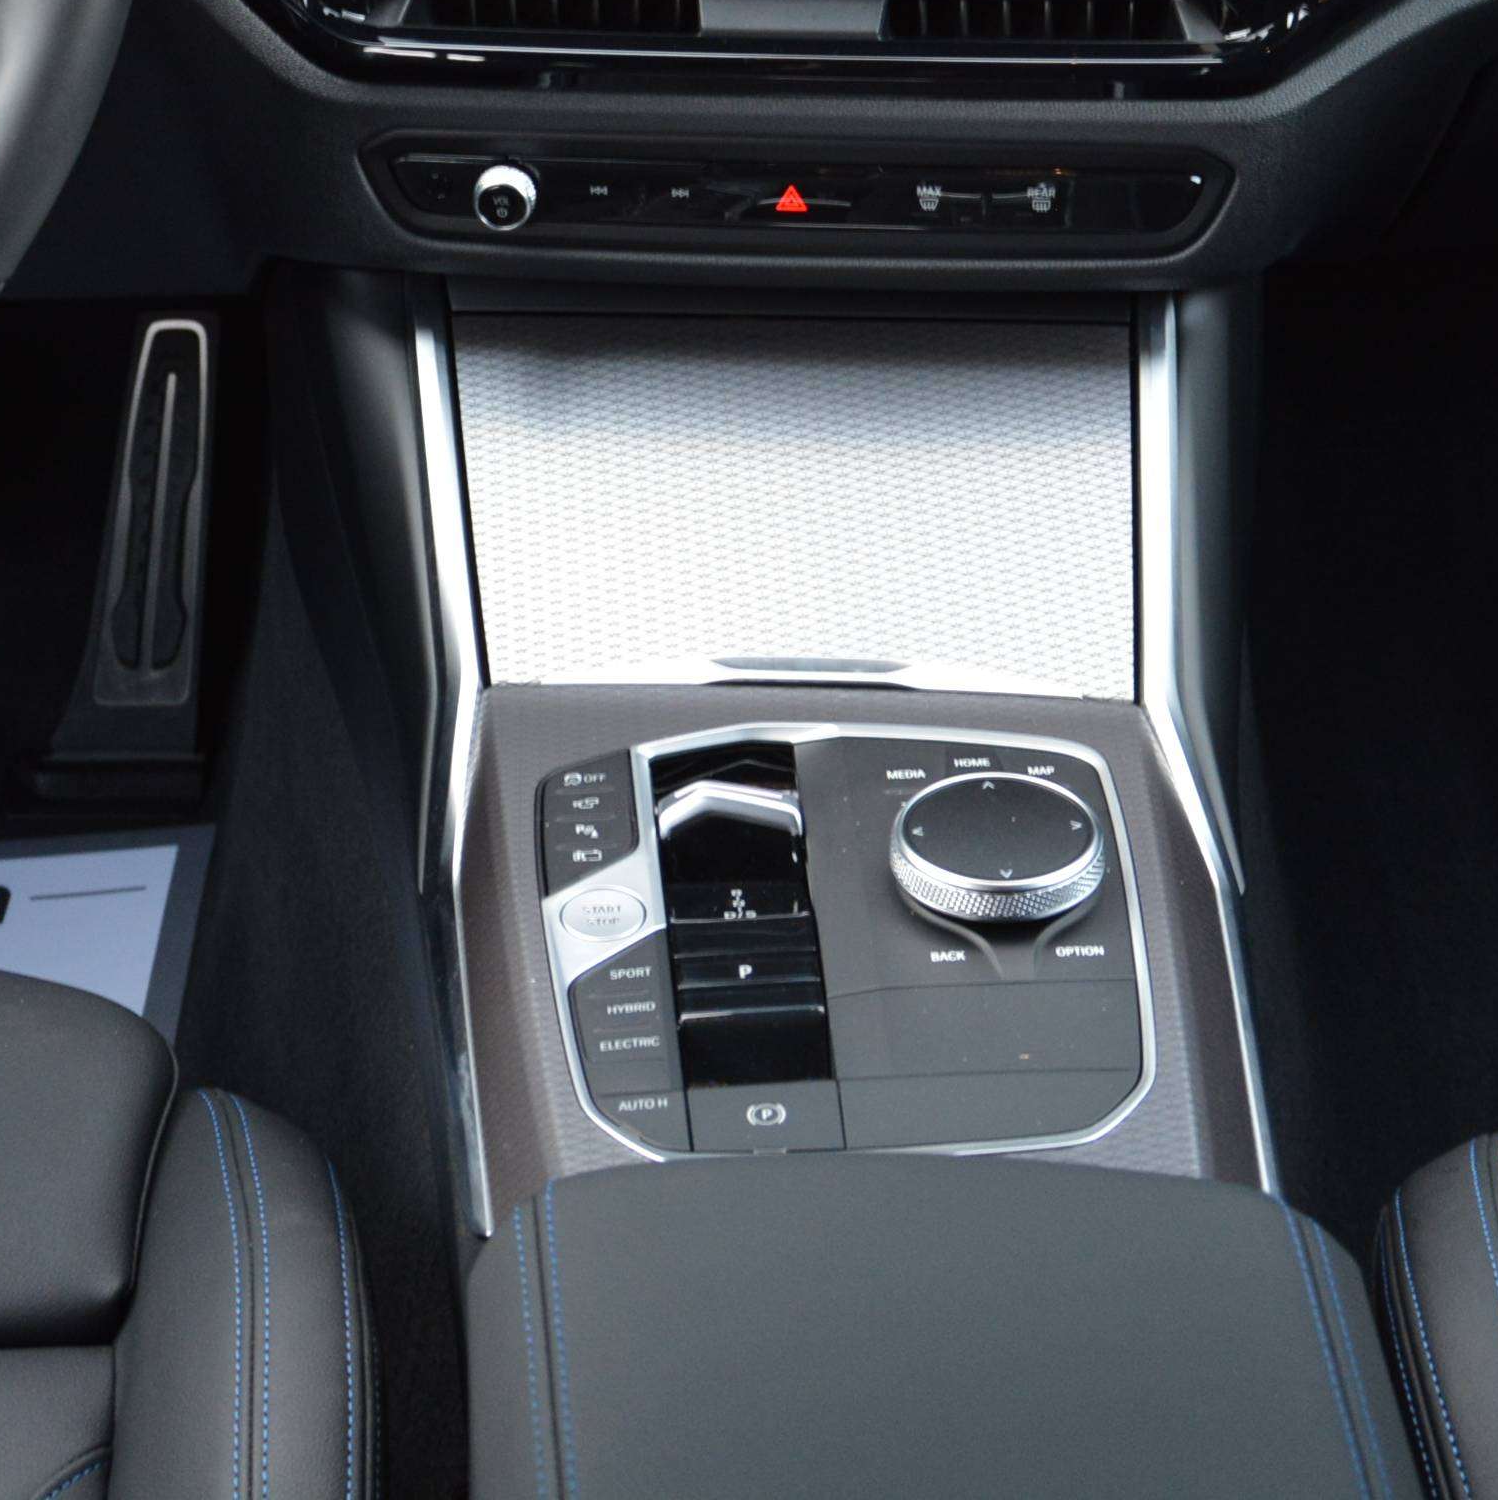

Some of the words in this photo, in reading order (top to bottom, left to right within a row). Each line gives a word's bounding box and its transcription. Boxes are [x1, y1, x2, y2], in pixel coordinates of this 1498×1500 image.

[916, 185, 942, 197] MAX
[1026, 187, 1056, 199] REAR
[954, 758, 991, 768] HOME
[886, 769, 926, 780] MEDIA
[1027, 765, 1055, 776] MAP
[583, 773, 606, 784] OFF
[582, 905, 621, 915] START
[586, 916, 620, 926] STOP
[930, 950, 966, 962] BACK
[1055, 945, 1105, 958] OPTION
[610, 966, 652, 980] SPORT
[738, 964, 753, 979] P
[606, 1001, 656, 1015] HYBRID
[599, 1036, 661, 1052] ELECTRIC
[618, 1098, 655, 1112] AUTO
[657, 1098, 668, 1108] H
